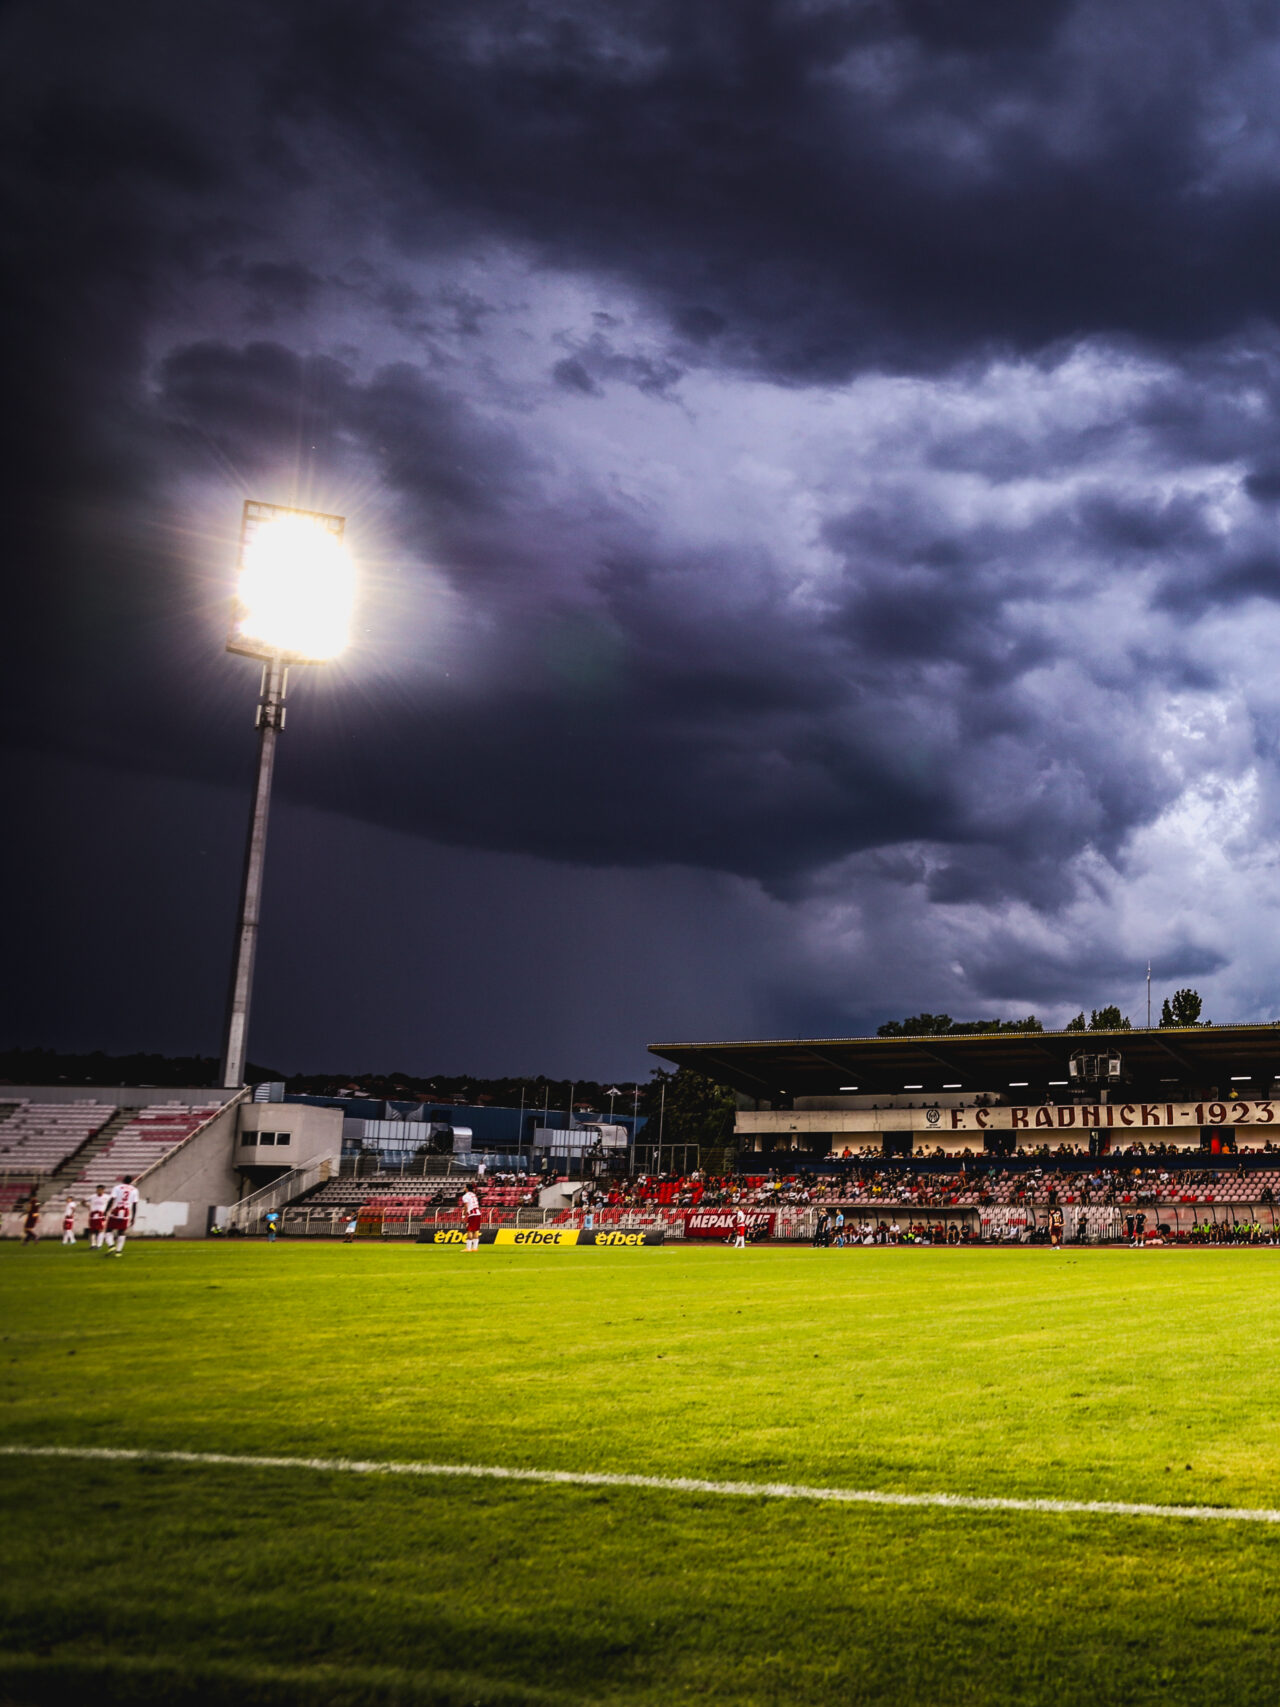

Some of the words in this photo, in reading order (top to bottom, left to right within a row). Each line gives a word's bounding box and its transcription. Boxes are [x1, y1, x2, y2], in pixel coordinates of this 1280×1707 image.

[689, 1214, 770, 1228] МЕРАКИЈЕ
[514, 1231, 562, 1244] efbet
[595, 1231, 646, 1245] efbet
